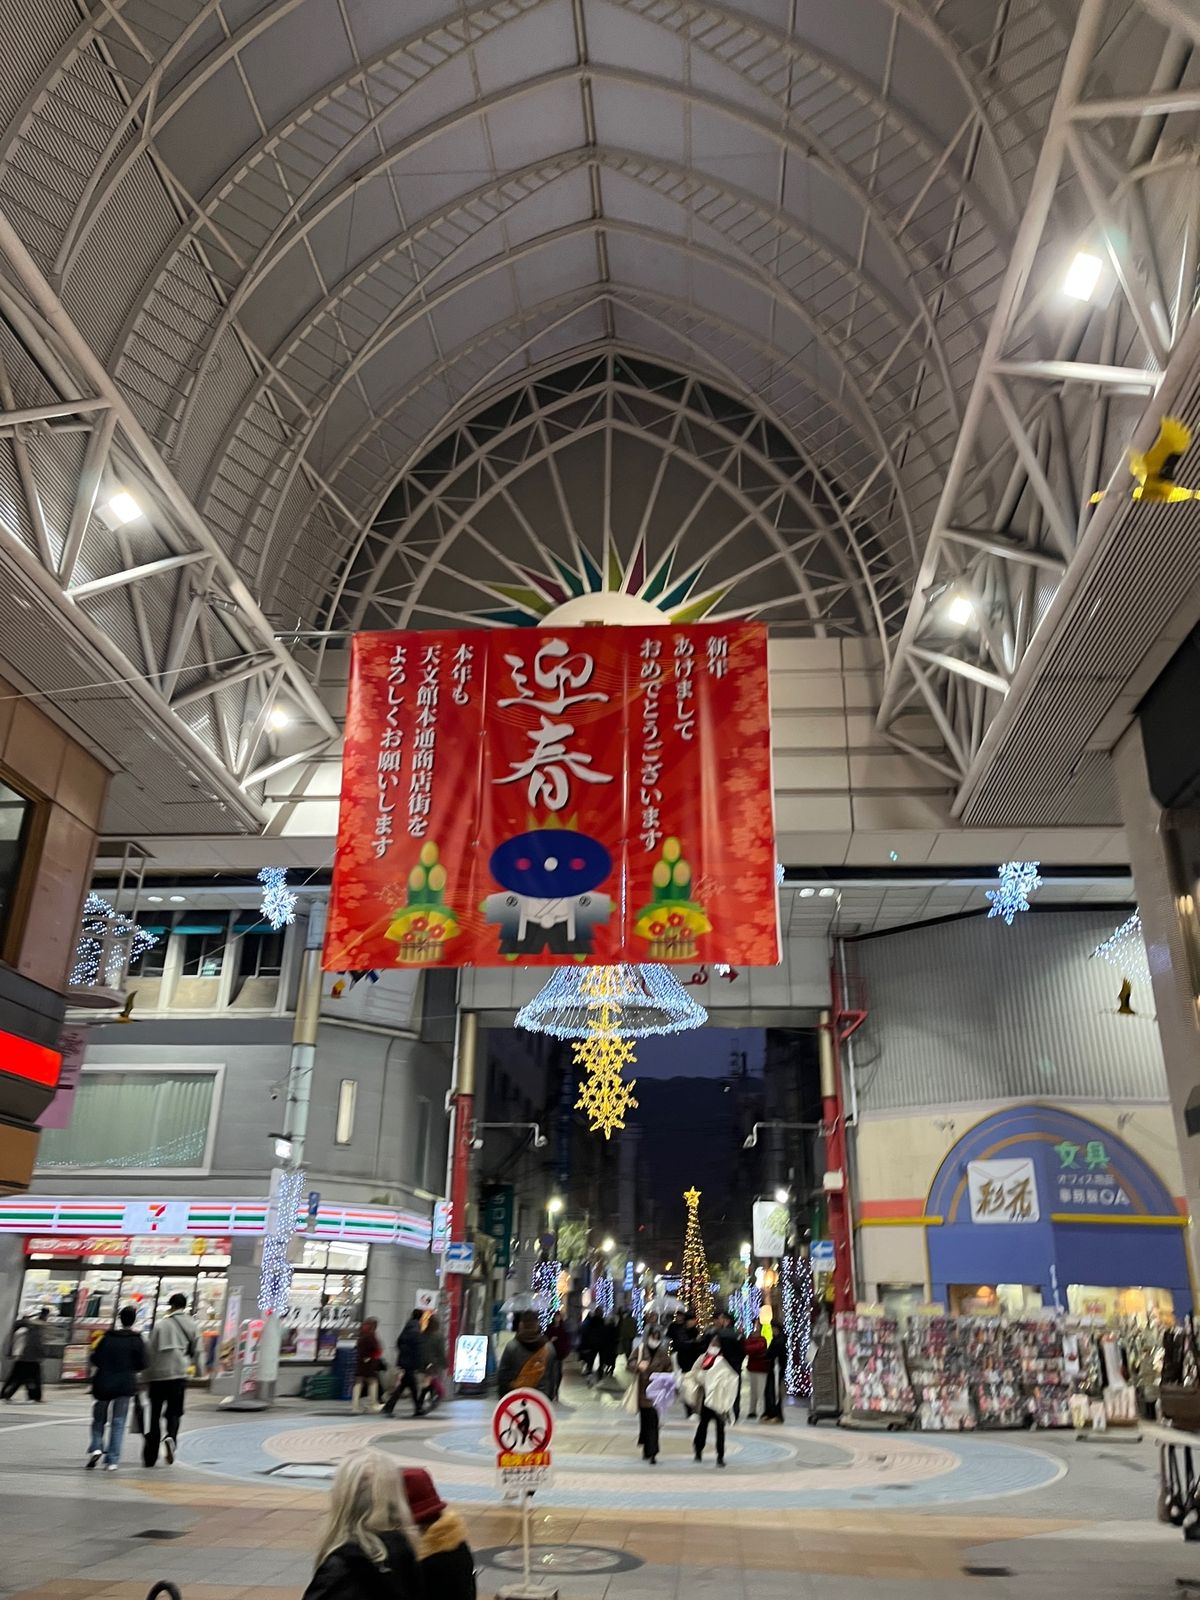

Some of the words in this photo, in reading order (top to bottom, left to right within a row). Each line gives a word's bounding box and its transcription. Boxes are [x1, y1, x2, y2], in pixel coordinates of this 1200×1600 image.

[451, 643, 474, 705] 本年も
[492, 638, 613, 810] 迎春
[673, 637, 695, 740] あけまして
[706, 635, 729, 679] 新年
[371, 645, 407, 859] よろしくお願いします
[407, 644, 441, 838] 天文館本通商店街を
[639, 638, 663, 852] おめでとうございます
[1054, 1141, 1111, 1171] 文具
